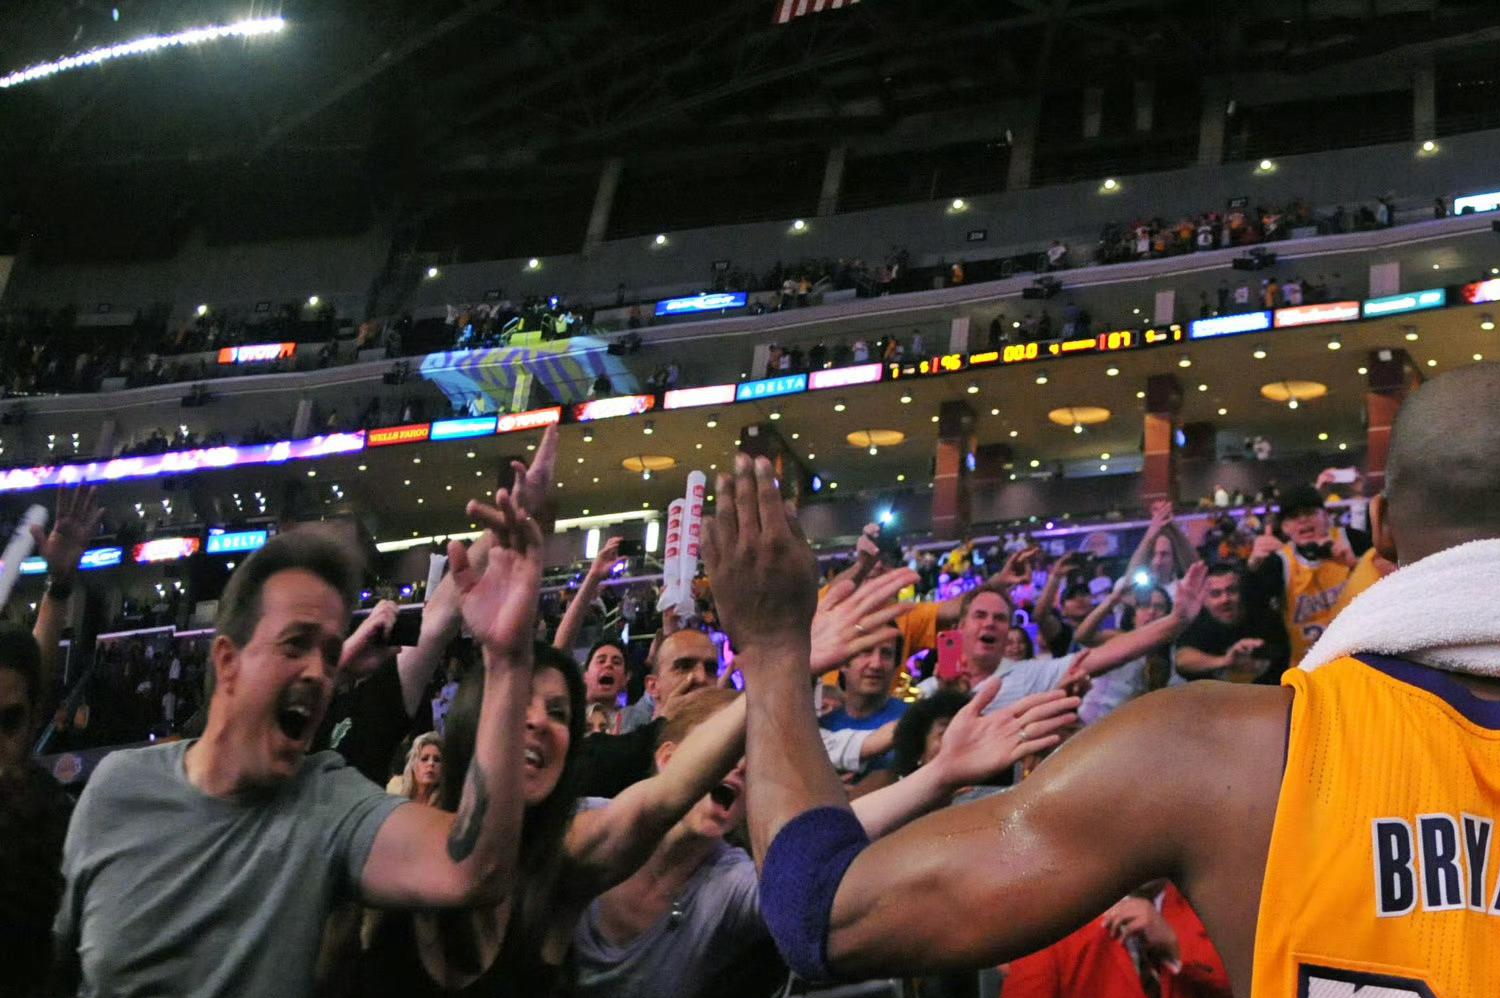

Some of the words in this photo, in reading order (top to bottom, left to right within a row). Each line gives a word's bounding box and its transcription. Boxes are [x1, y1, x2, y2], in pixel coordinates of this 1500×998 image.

[755, 376, 805, 394] DELTA
[370, 429, 399, 442] WELLS
[399, 427, 429, 440] FARGO
[223, 534, 265, 551] DELTA
